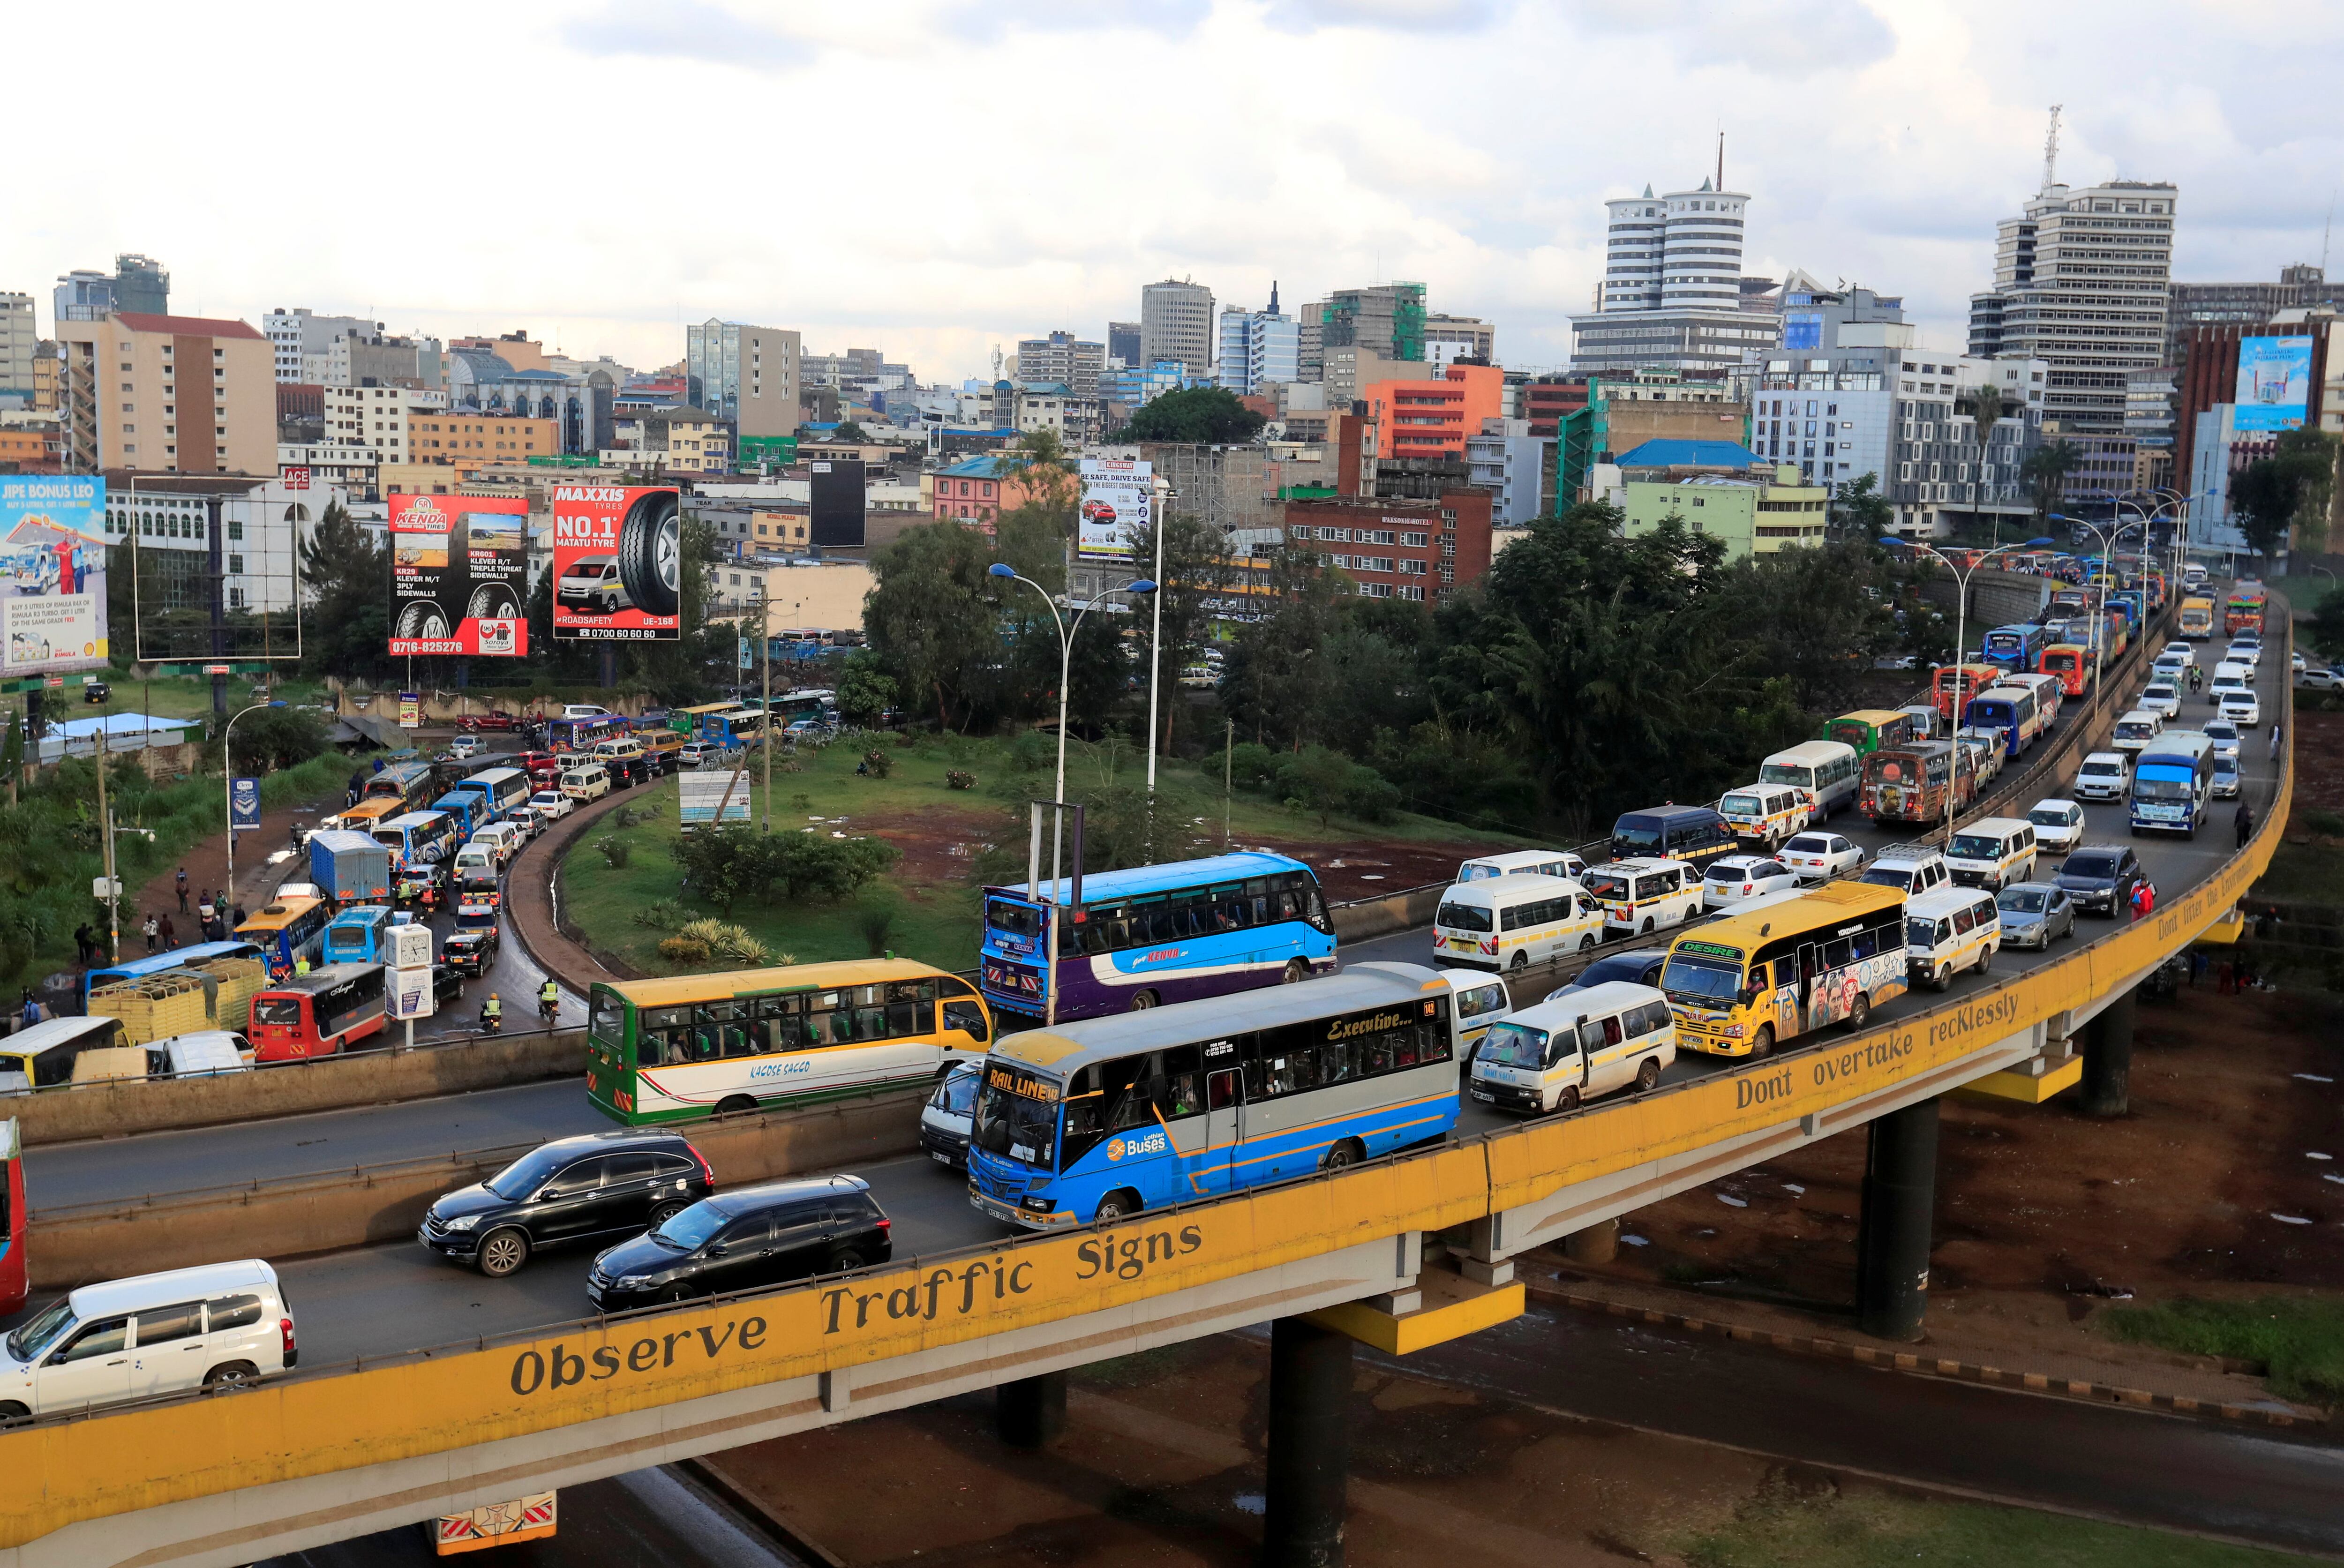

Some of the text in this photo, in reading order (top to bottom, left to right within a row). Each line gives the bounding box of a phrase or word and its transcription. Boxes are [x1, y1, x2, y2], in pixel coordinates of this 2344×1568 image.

[287, 471, 308, 482] ACE
[2, 484, 94, 498] JIPE BONUS LEO
[555, 487, 624, 502] MAXXIS
[395, 512, 447, 525] KENDA
[556, 538, 615, 548] MATATU TYRE
[592, 629, 615, 638] 0700
[392, 641, 463, 653] 0716-825276
[2183, 900, 2202, 925] litter
[2207, 887, 2218, 908] the
[995, 939, 1009, 948] JOY
[1014, 943, 1033, 953] KENYA
[1684, 943, 1737, 957] DESIRE
[1132, 955, 1147, 969] Joy
[1148, 948, 1179, 962] KENYA
[330, 980, 355, 996] Angel
[1425, 1005, 1434, 1014] 142
[1683, 1011, 1710, 1022] STAR BUS
[1813, 1033, 1913, 1086] overtake
[783, 1060, 811, 1075] SACCO
[1483, 1068, 1516, 1083] HOME SACCO
[990, 1069, 1047, 1100] RAIL LINE
[1047, 1088, 1059, 1100] 142
[1144, 1132, 1164, 1141] Lothian
[1127, 1137, 1165, 1156] Buses
[996, 1158, 1013, 1168] Lothian
[510, 1224, 1202, 1397] Observe Traffic Signs
